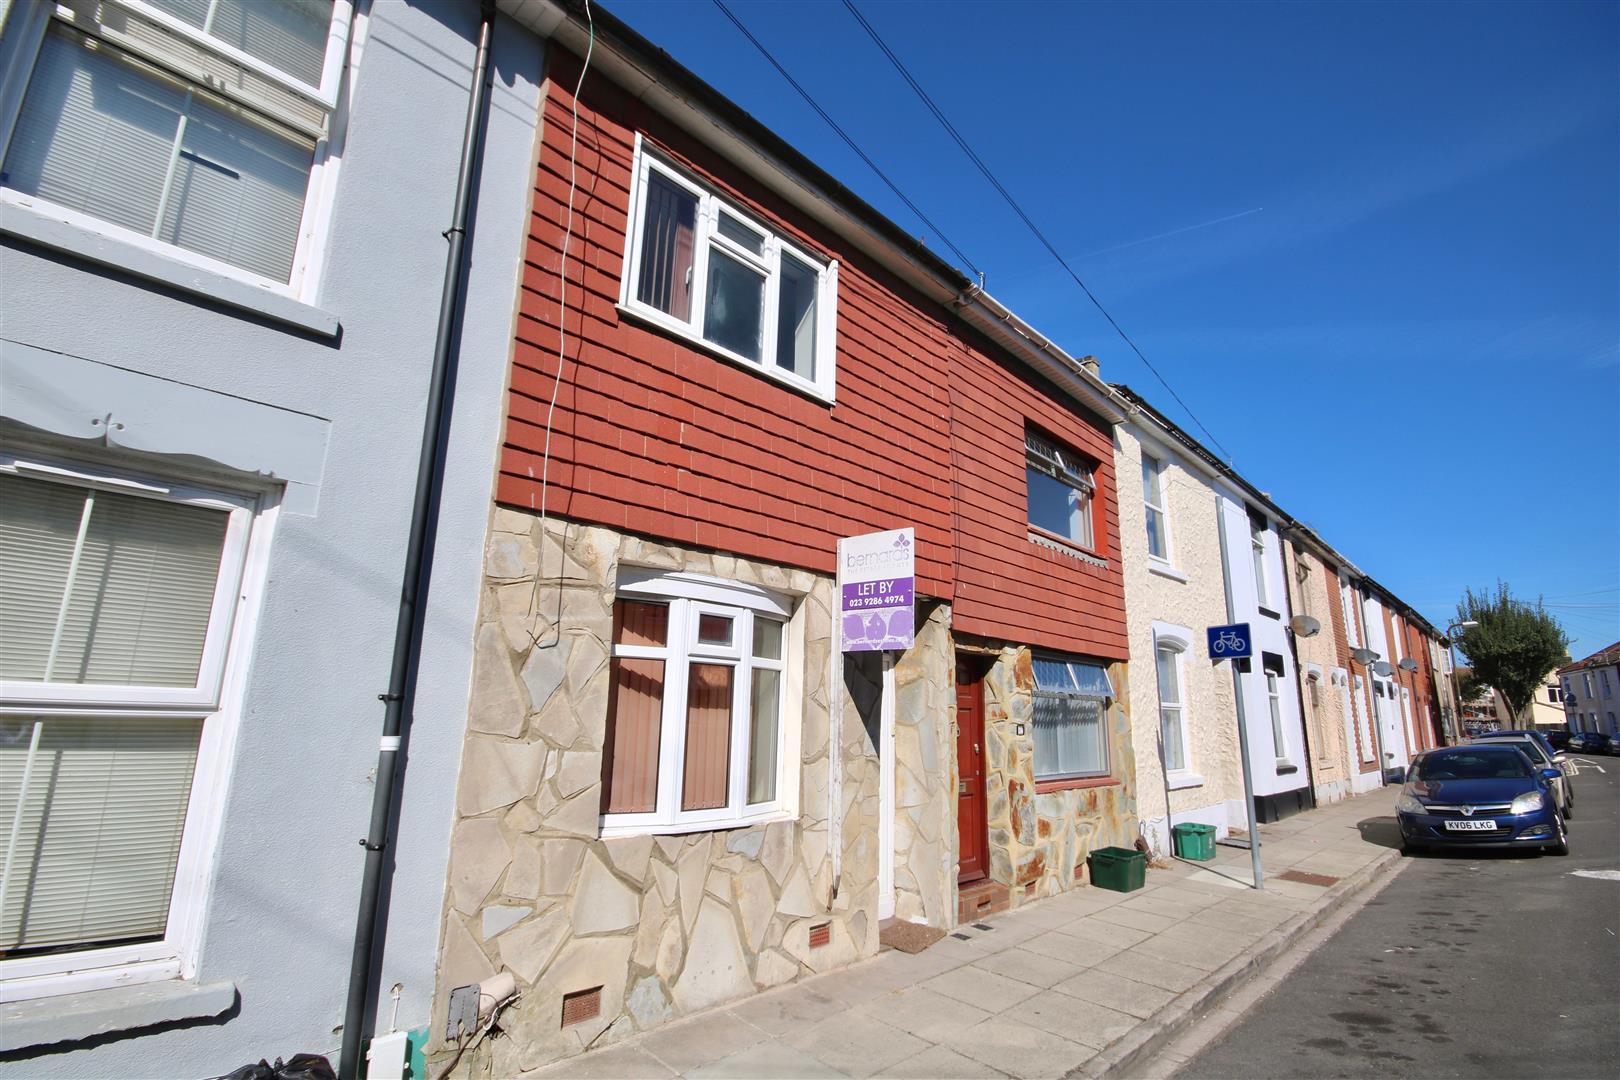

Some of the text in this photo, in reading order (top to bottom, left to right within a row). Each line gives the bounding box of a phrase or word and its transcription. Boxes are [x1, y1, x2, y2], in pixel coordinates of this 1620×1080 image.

[847, 548, 910, 567] bernards
[858, 580, 894, 596] LET BY
[849, 594, 905, 607] 023 9286 4974
[1448, 821, 1493, 830] KV06 LKG
